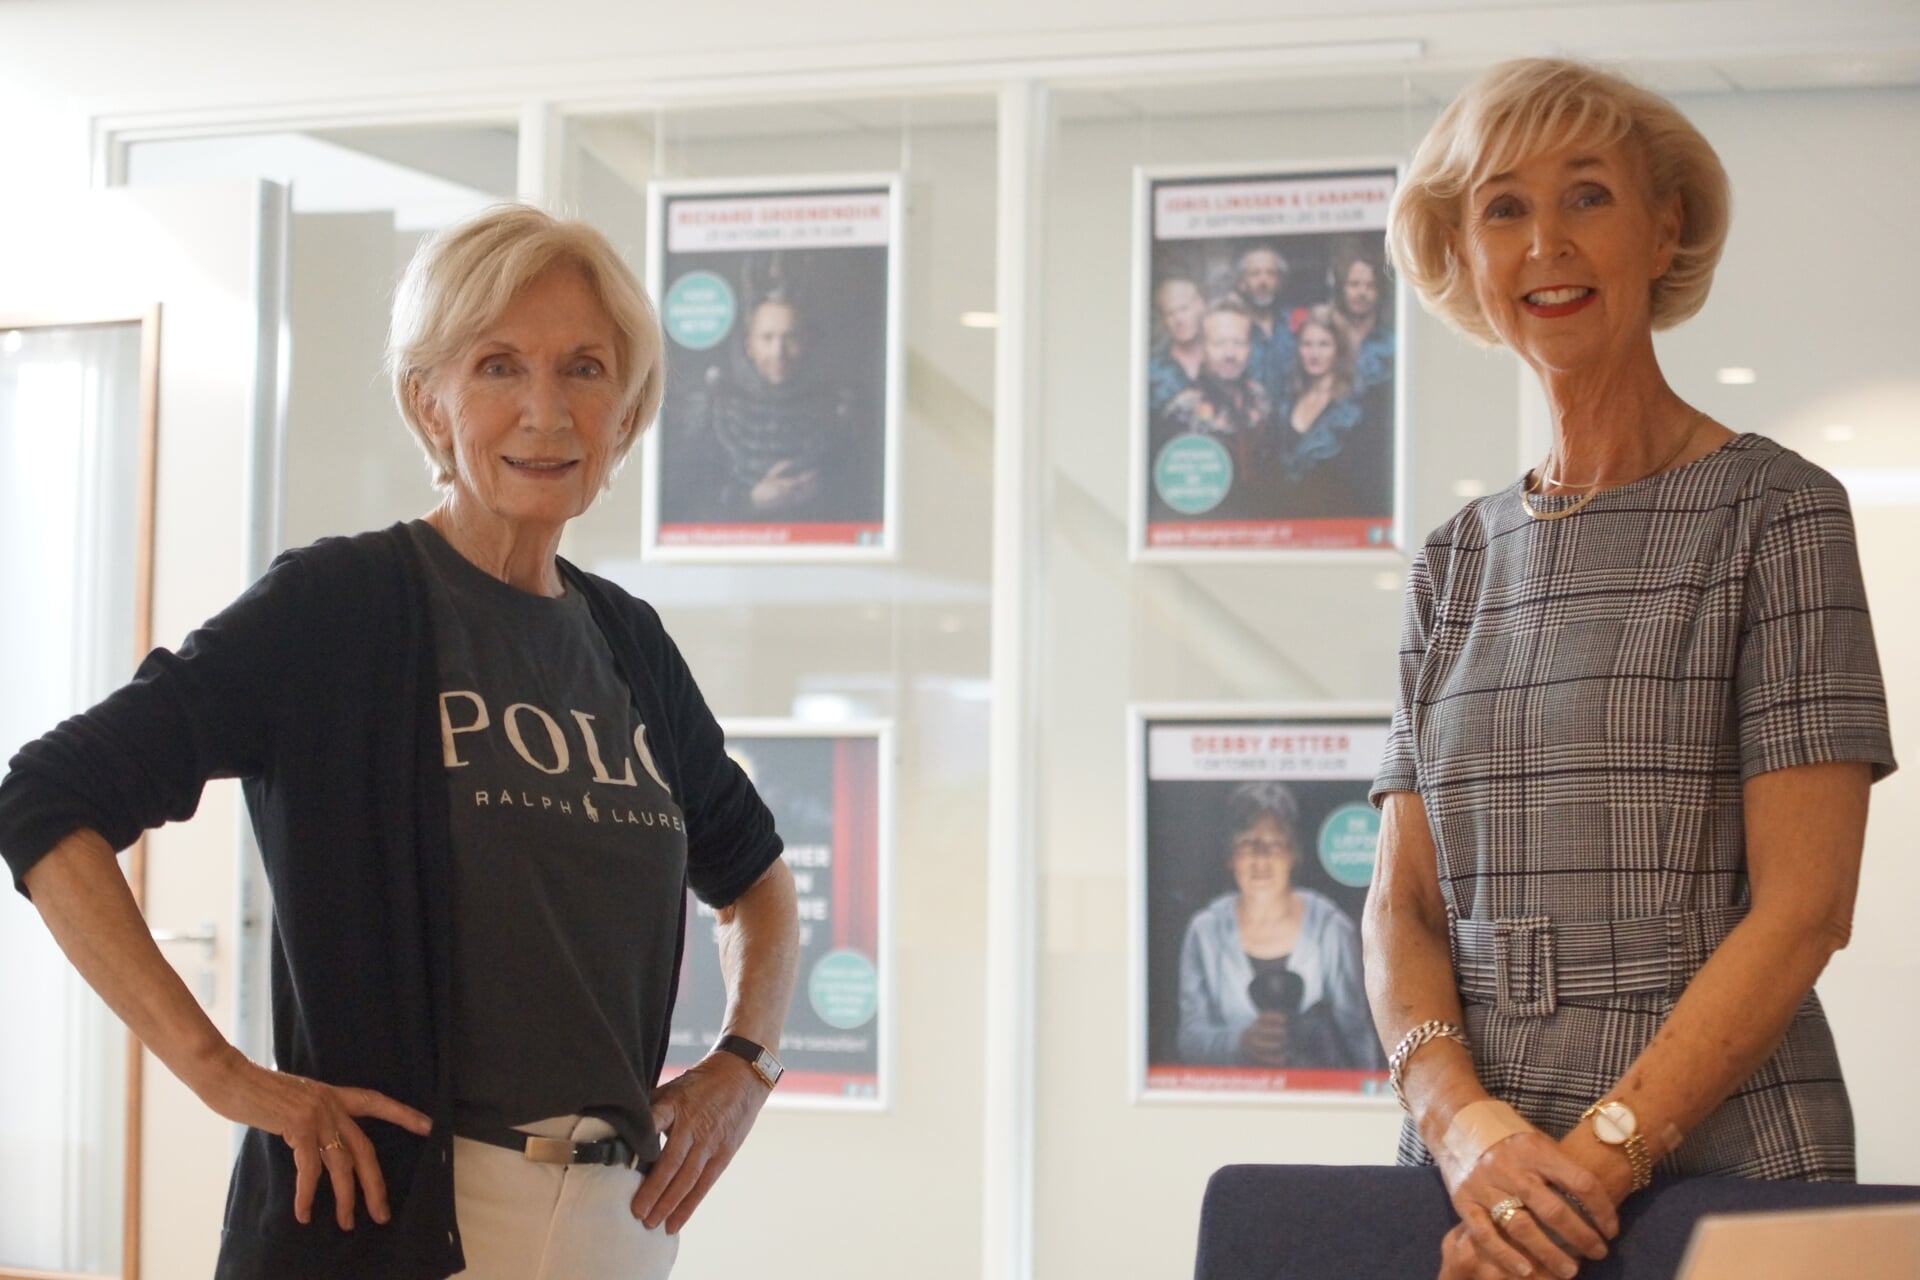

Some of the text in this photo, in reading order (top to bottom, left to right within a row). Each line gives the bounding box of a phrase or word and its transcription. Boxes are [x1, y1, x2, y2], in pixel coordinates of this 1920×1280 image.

[677, 208, 753, 225] RICHARD
[1191, 735, 1350, 754] DEBBY PETTER
[475, 789, 573, 815] RALPH
